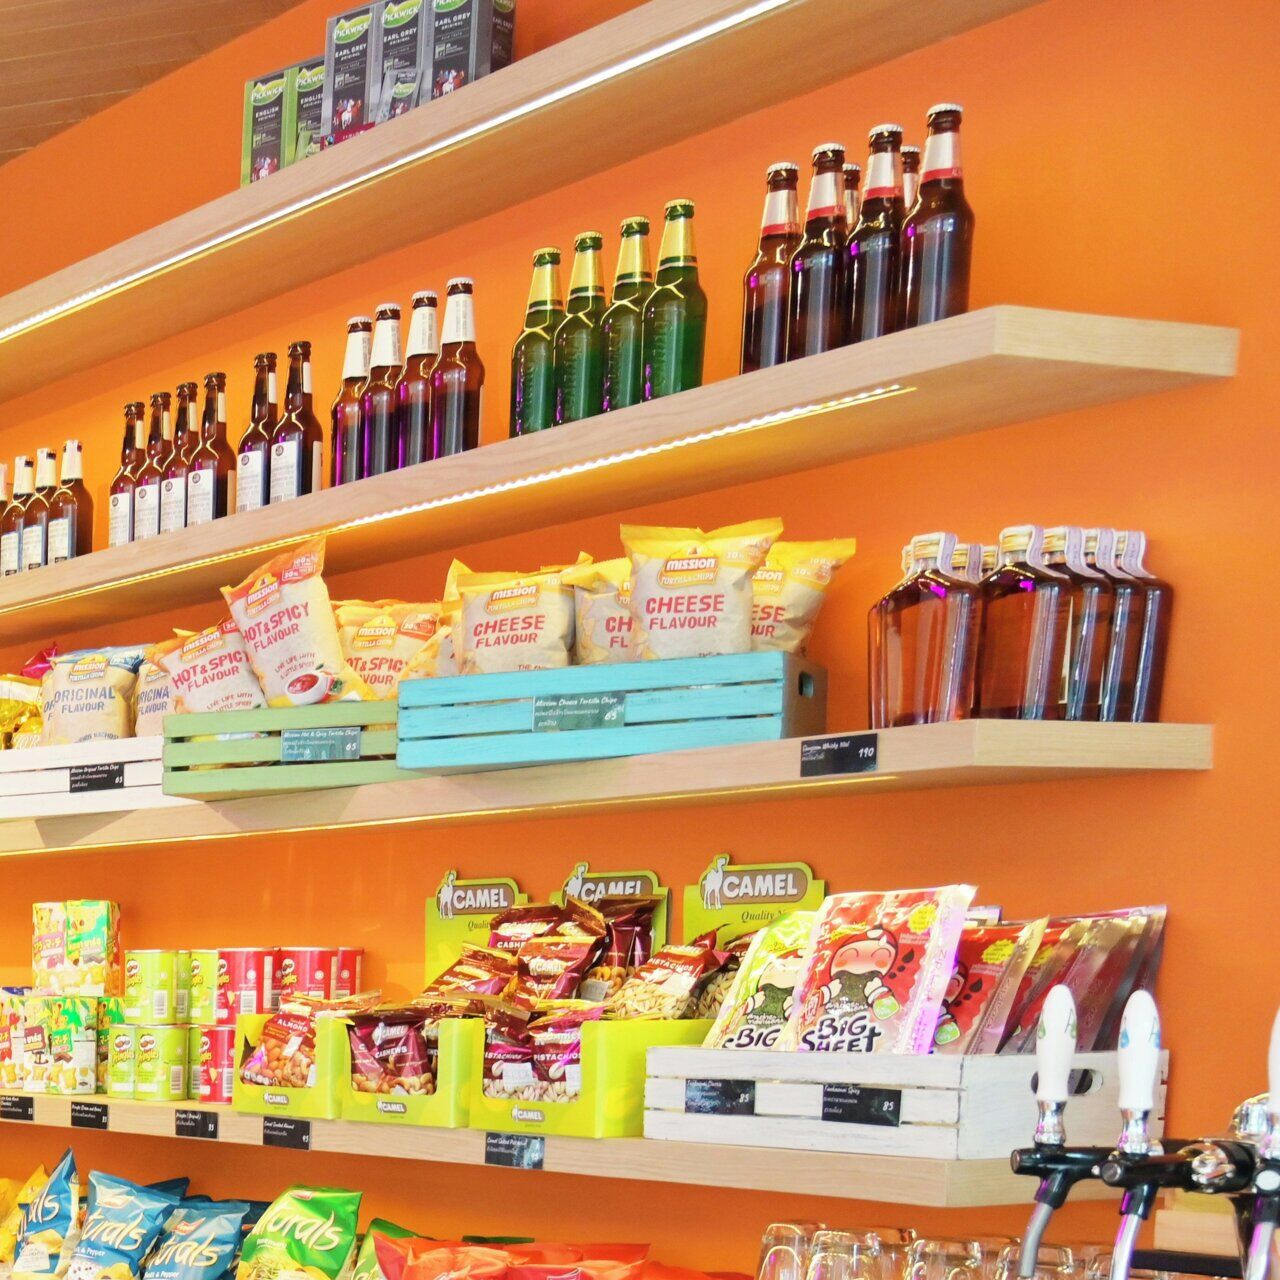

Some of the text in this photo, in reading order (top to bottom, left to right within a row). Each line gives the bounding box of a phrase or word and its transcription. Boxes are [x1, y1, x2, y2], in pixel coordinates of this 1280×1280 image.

[435, 12, 471, 27] EARL GREY
[384, 28, 417, 43] EARL GREY
[335, 43, 367, 57] EARL GREY
[255, 107, 279, 118] ENGLISH
[645, 594, 725, 615] CHEESE
[271, 602, 310, 628] SPICY
[649, 614, 718, 630] FLAVOUR
[473, 614, 546, 636] CHEESE
[254, 623, 300, 652] FLAVOUR
[475, 632, 538, 649] FLAVOUR
[173, 664, 199, 689] HOT
[201, 665, 207, 673] &
[187, 666, 240, 692] FLAVOUR
[54, 687, 116, 701] ORIGINAL
[62, 702, 104, 714] FLAVOUR
[605, 712, 617, 720] 65
[345, 743, 357, 751] 65
[859, 748, 874, 757] 190
[115, 775, 123, 784] 65
[723, 874, 798, 898] CAMEL
[452, 887, 509, 909] CAMEL
[741, 910, 775, 923] Quality
[277, 1019, 308, 1033] ALMOND
[818, 1016, 867, 1040] BIG
[735, 1028, 781, 1048] BIG
[375, 1046, 407, 1059] CASHEWS
[269, 1095, 288, 1104] CAMEL
[740, 1093, 749, 1103] 85
[383, 1104, 404, 1112] CAMEL
[882, 1101, 894, 1111] 85
[518, 1111, 543, 1120] CAMEL
